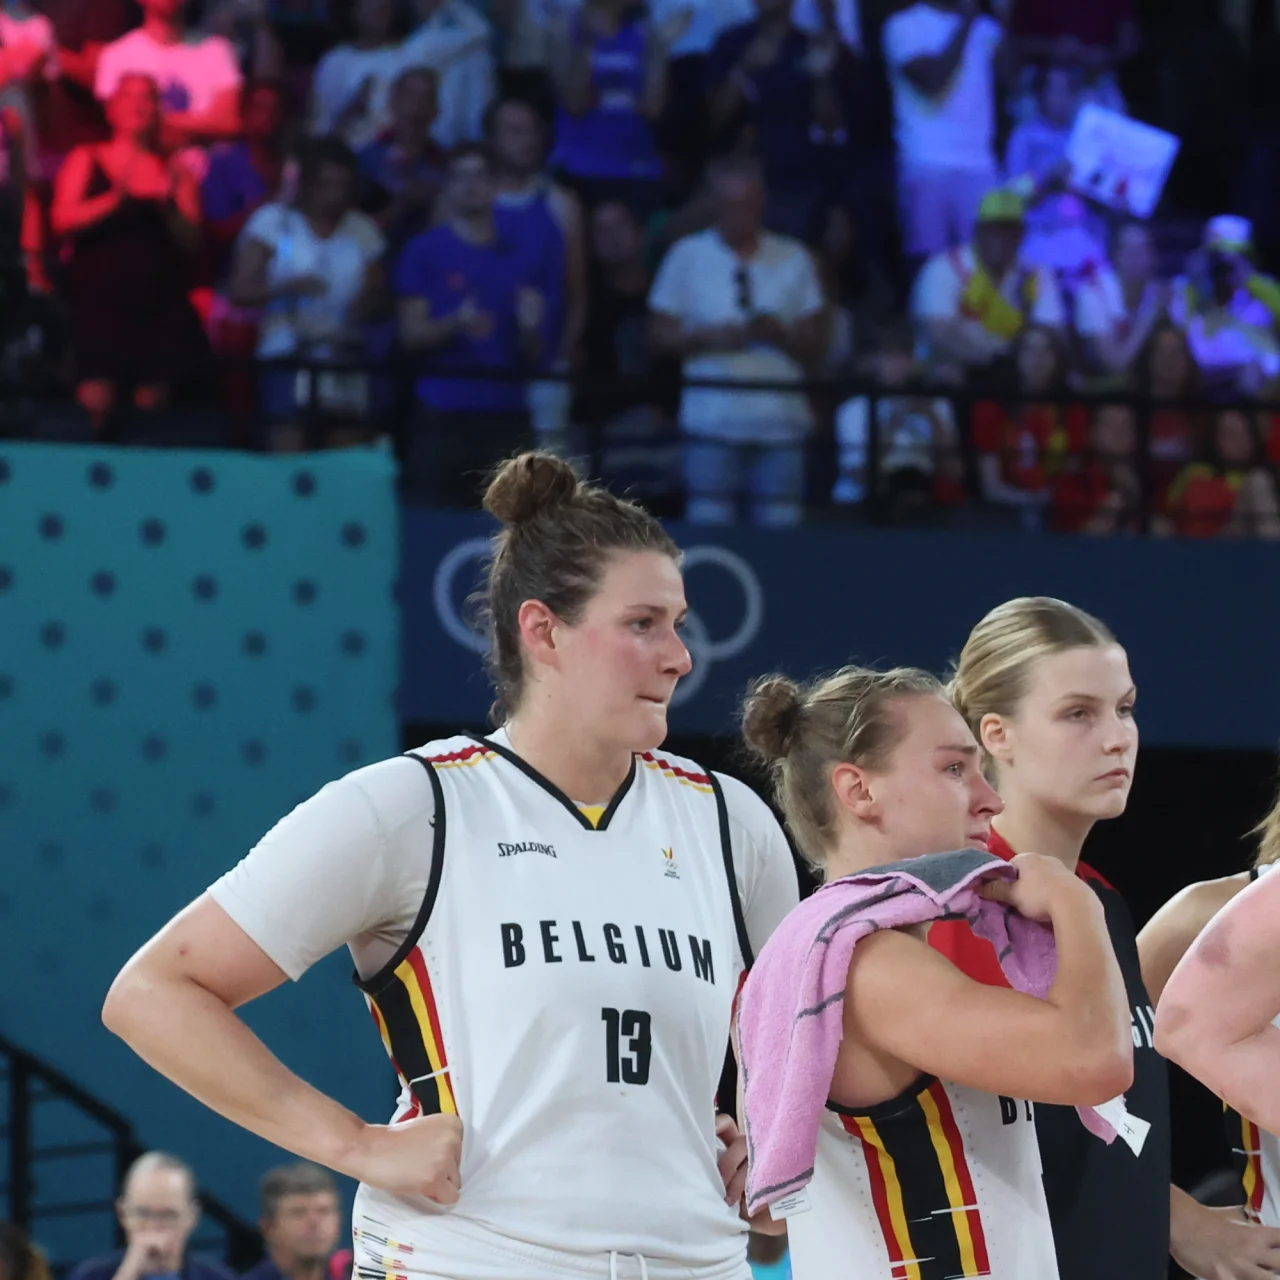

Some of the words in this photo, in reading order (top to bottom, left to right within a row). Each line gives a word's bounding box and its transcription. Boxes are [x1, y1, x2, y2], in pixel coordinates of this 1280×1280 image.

[497, 842, 558, 859] SPALDING
[501, 920, 716, 985] BELGIUM
[601, 1007, 652, 1086] 13
